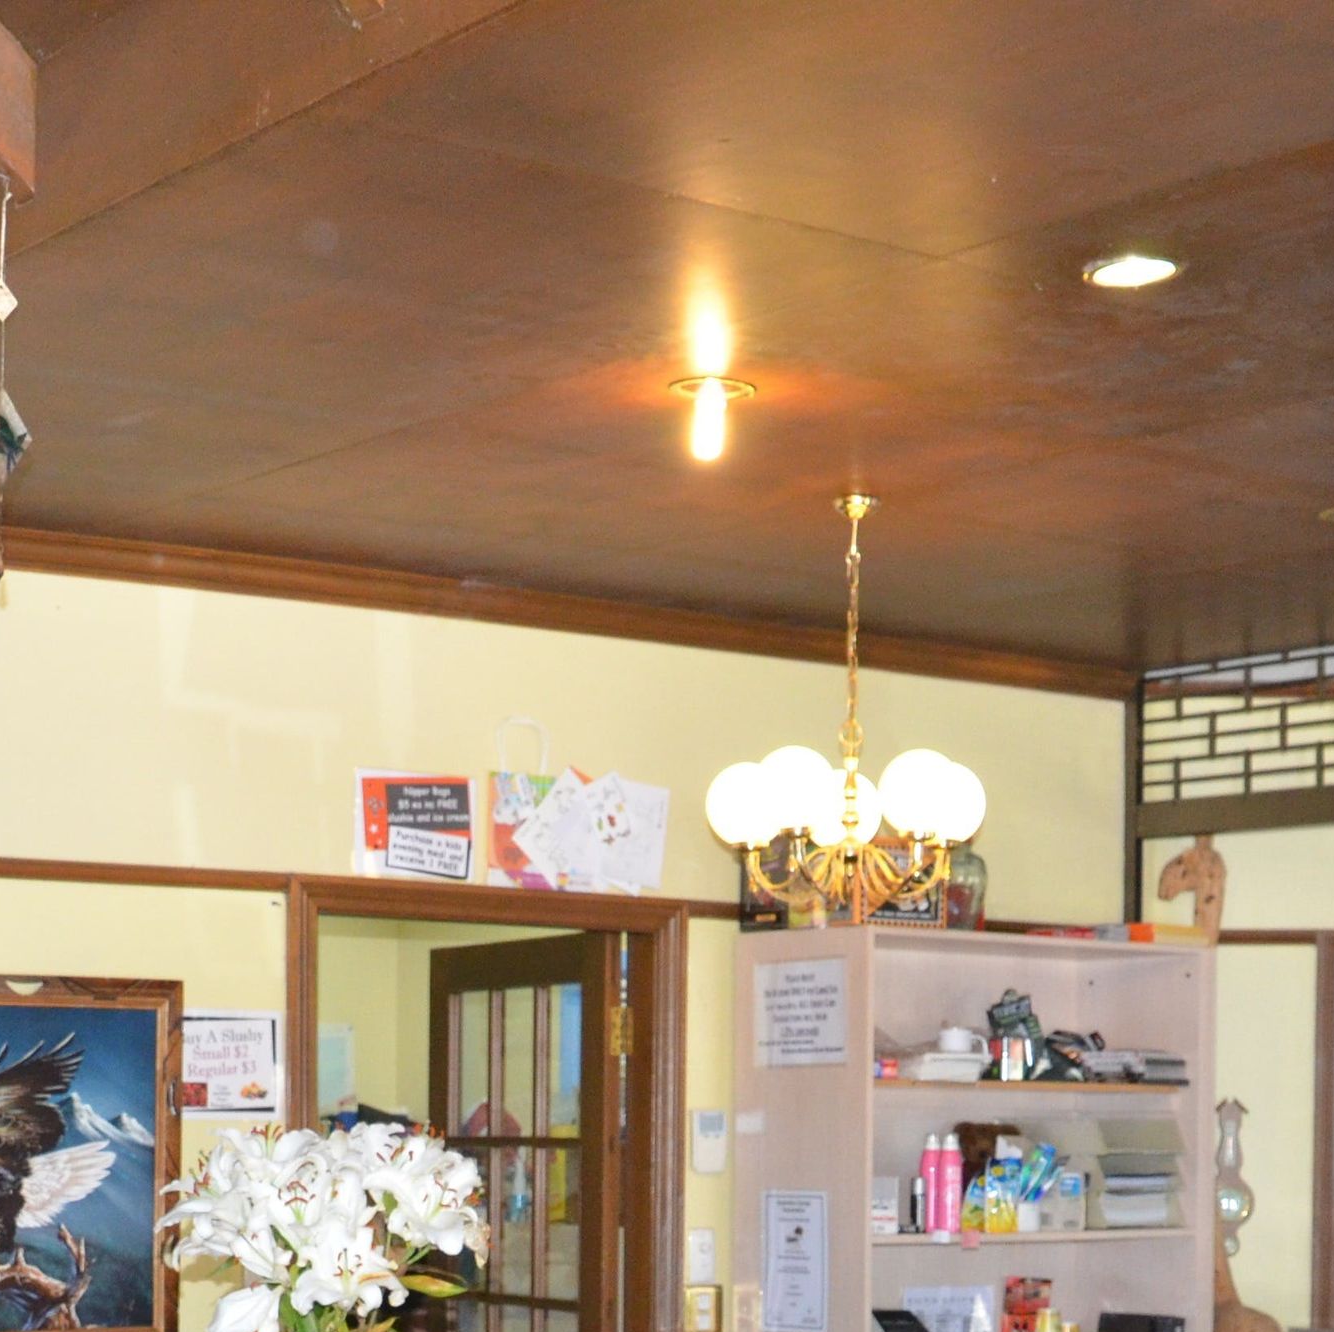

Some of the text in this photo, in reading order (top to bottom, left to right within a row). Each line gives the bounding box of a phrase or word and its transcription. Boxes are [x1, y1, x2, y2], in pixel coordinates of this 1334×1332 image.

[206, 1029, 218, 1043] A
[221, 1028, 264, 1046] Slushy
[191, 1044, 250, 1060] Small $2
[187, 1062, 237, 1078] Regular
